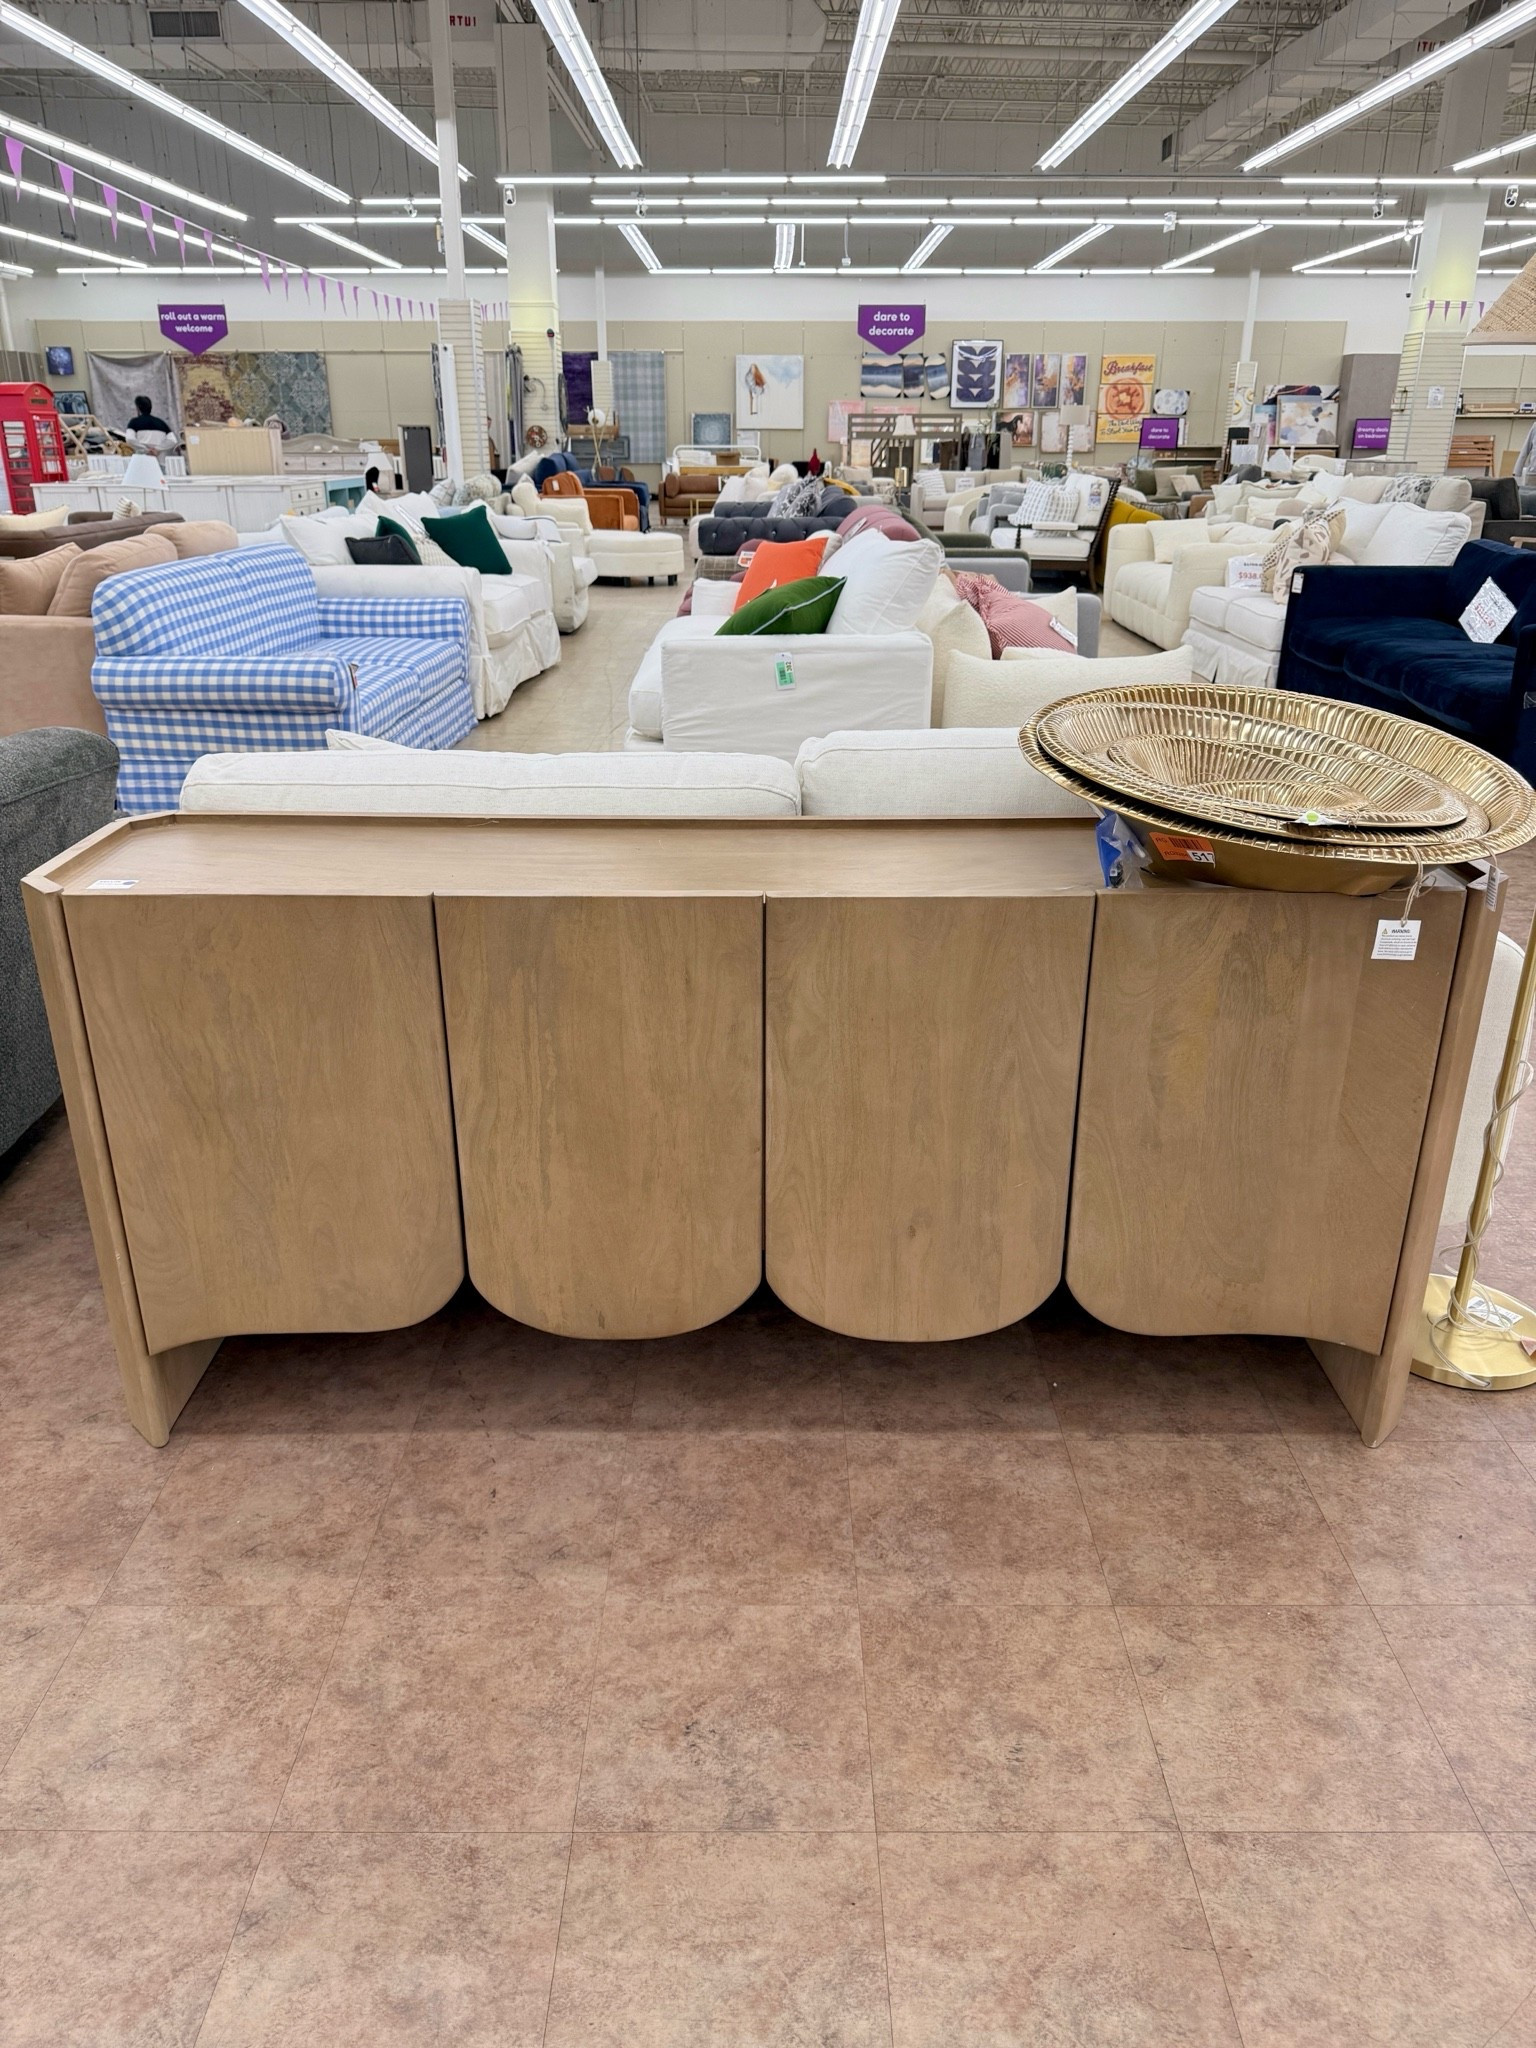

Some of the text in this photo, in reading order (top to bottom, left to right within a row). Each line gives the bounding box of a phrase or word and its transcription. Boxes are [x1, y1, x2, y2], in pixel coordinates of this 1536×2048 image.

[160, 312, 176, 320] roll
[873, 311, 910, 321] dare to
[175, 324, 213, 333] welcome
[868, 325, 914, 336] decorate
[1104, 360, 1154, 376] Breakfast
